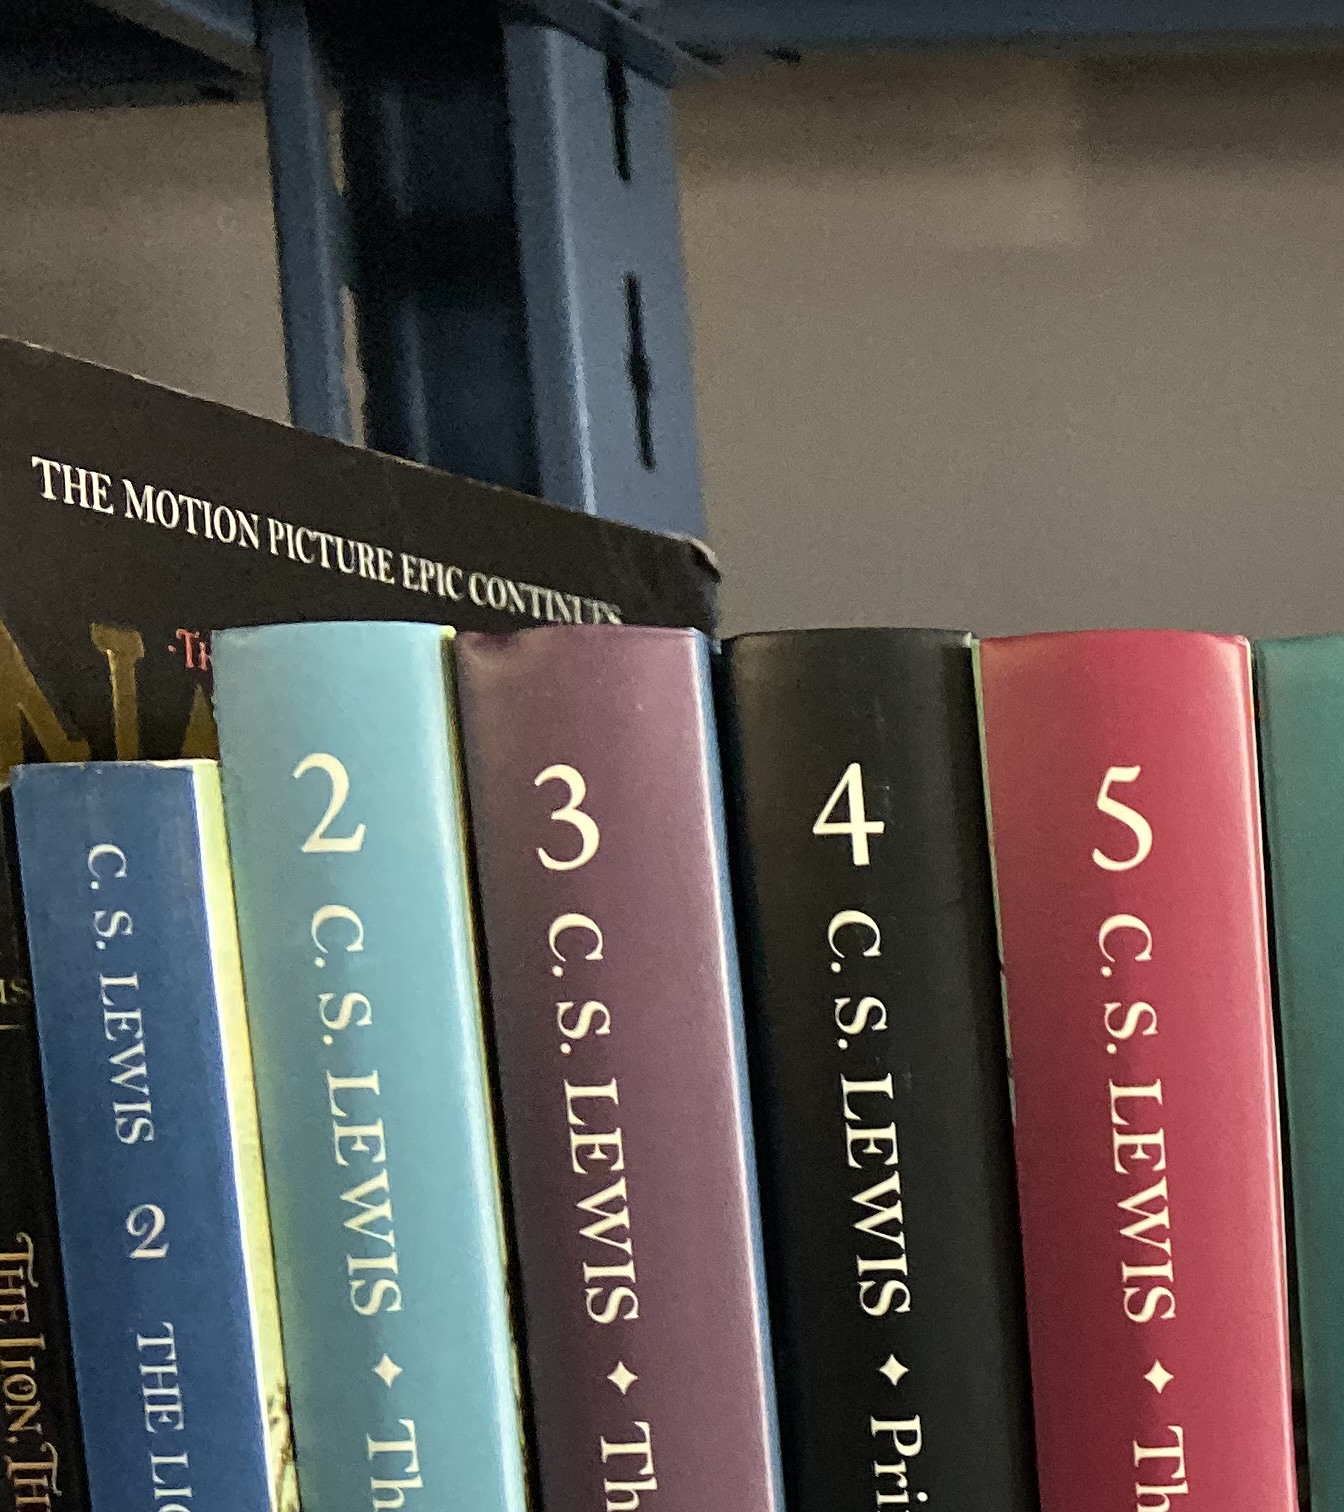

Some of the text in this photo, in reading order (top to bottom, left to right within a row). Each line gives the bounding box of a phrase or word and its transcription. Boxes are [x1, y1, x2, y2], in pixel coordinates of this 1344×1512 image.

[123, 479, 260, 550] MOTION
[268, 517, 395, 585] PICTURE
[401, 553, 463, 600] EPIC
[293, 752, 366, 853] 2
[534, 764, 600, 872] 3
[813, 763, 885, 867] 4
[1091, 765, 1153, 871] 5
[87, 844, 170, 1259] C. S. LEWIS 2
[827, 909, 911, 1318] C. S. LEWIS
[325, 1070, 402, 1316] LEWIS
[563, 1078, 640, 1324] LEWIS
[1108, 1077, 1177, 1323] LEWIS
